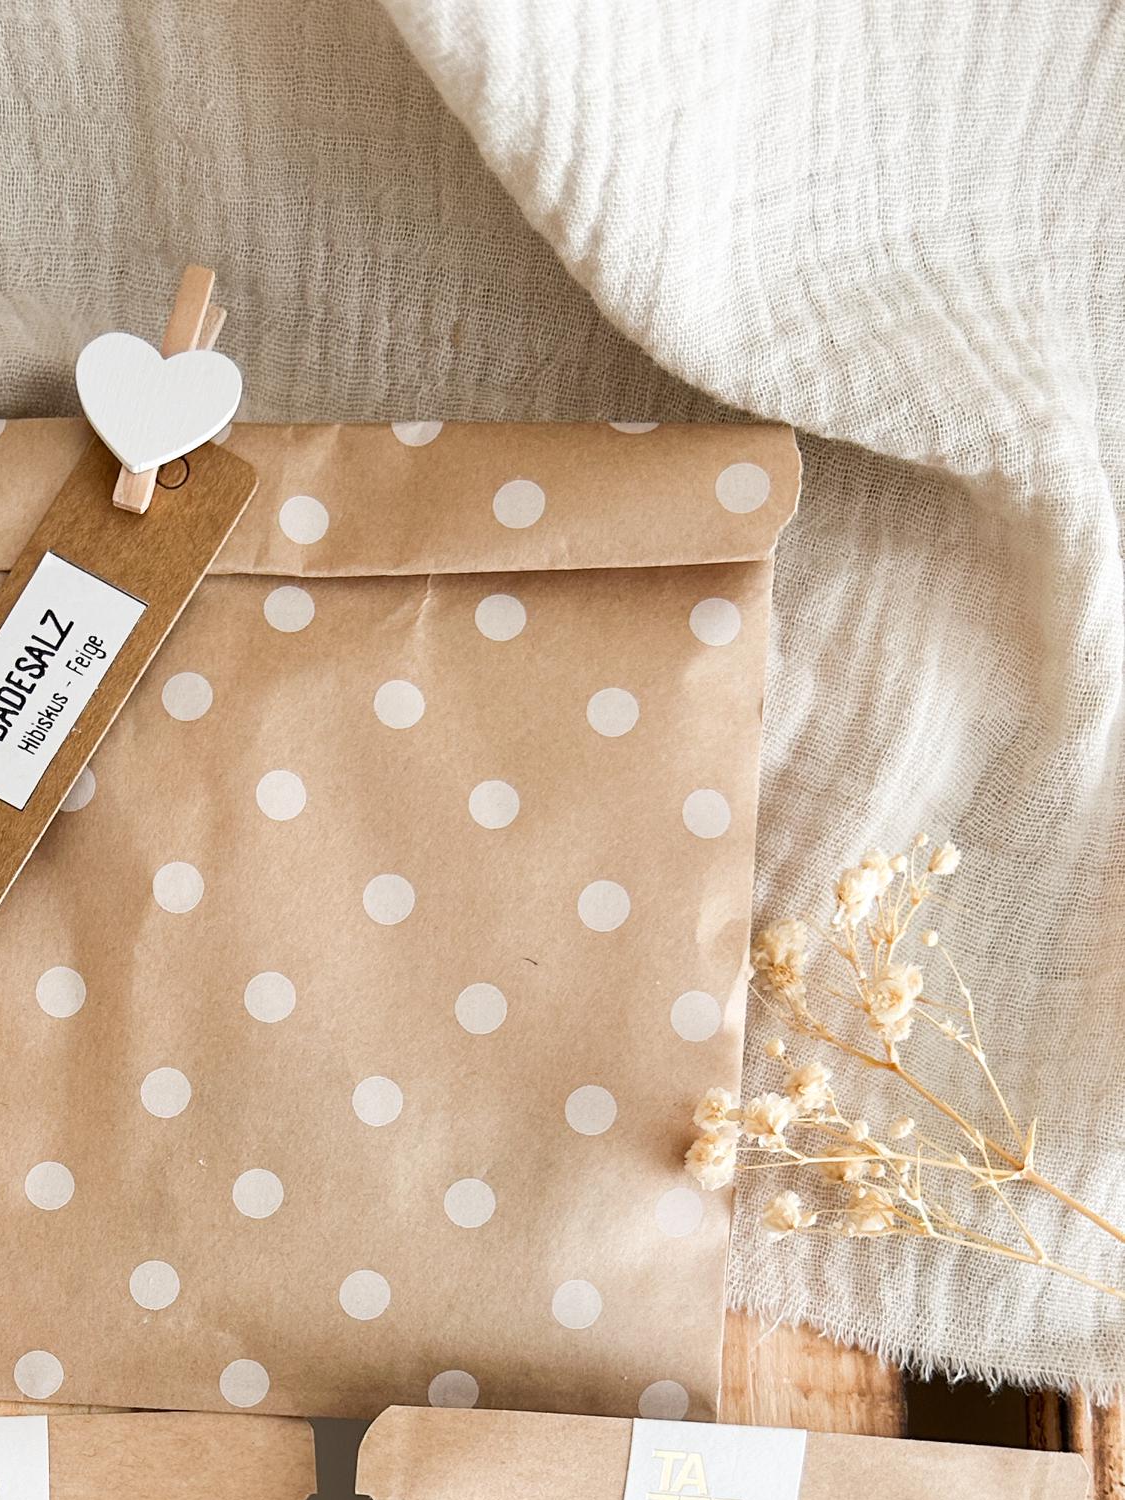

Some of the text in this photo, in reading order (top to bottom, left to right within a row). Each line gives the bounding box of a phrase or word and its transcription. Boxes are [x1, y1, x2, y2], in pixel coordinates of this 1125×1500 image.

[17, 692, 69, 755] Hibiskus
[65, 635, 107, 677] Feige
[651, 1448, 709, 1495] TA
